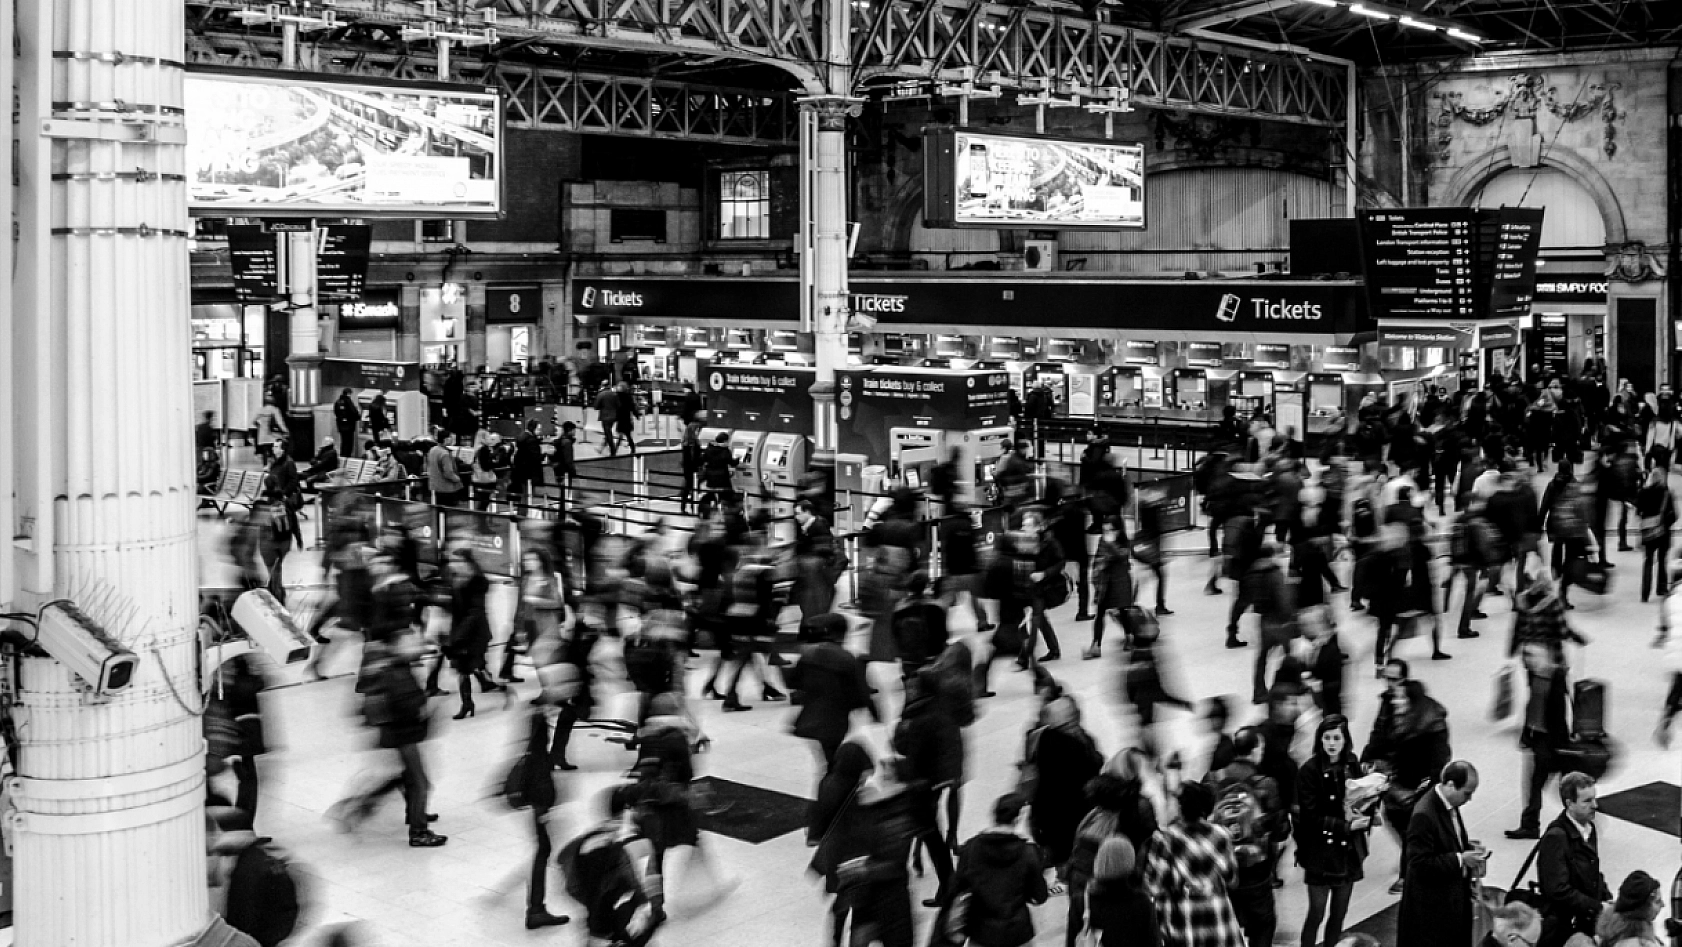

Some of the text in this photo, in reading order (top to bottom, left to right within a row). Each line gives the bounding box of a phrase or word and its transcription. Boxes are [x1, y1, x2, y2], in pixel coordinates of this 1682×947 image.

[1557, 282, 1588, 293] SIMPLY
[601, 291, 642, 307] Tickets
[854, 295, 905, 312] Tickets
[1250, 298, 1322, 320] Tickets
[726, 374, 739, 383] Train
[740, 374, 759, 384] tickets
[760, 375, 770, 387] buy
[778, 376, 796, 387] collect
[862, 378, 879, 388] Train
[880, 378, 902, 390] tickets
[903, 380, 914, 392] buy
[923, 381, 945, 392] collect
